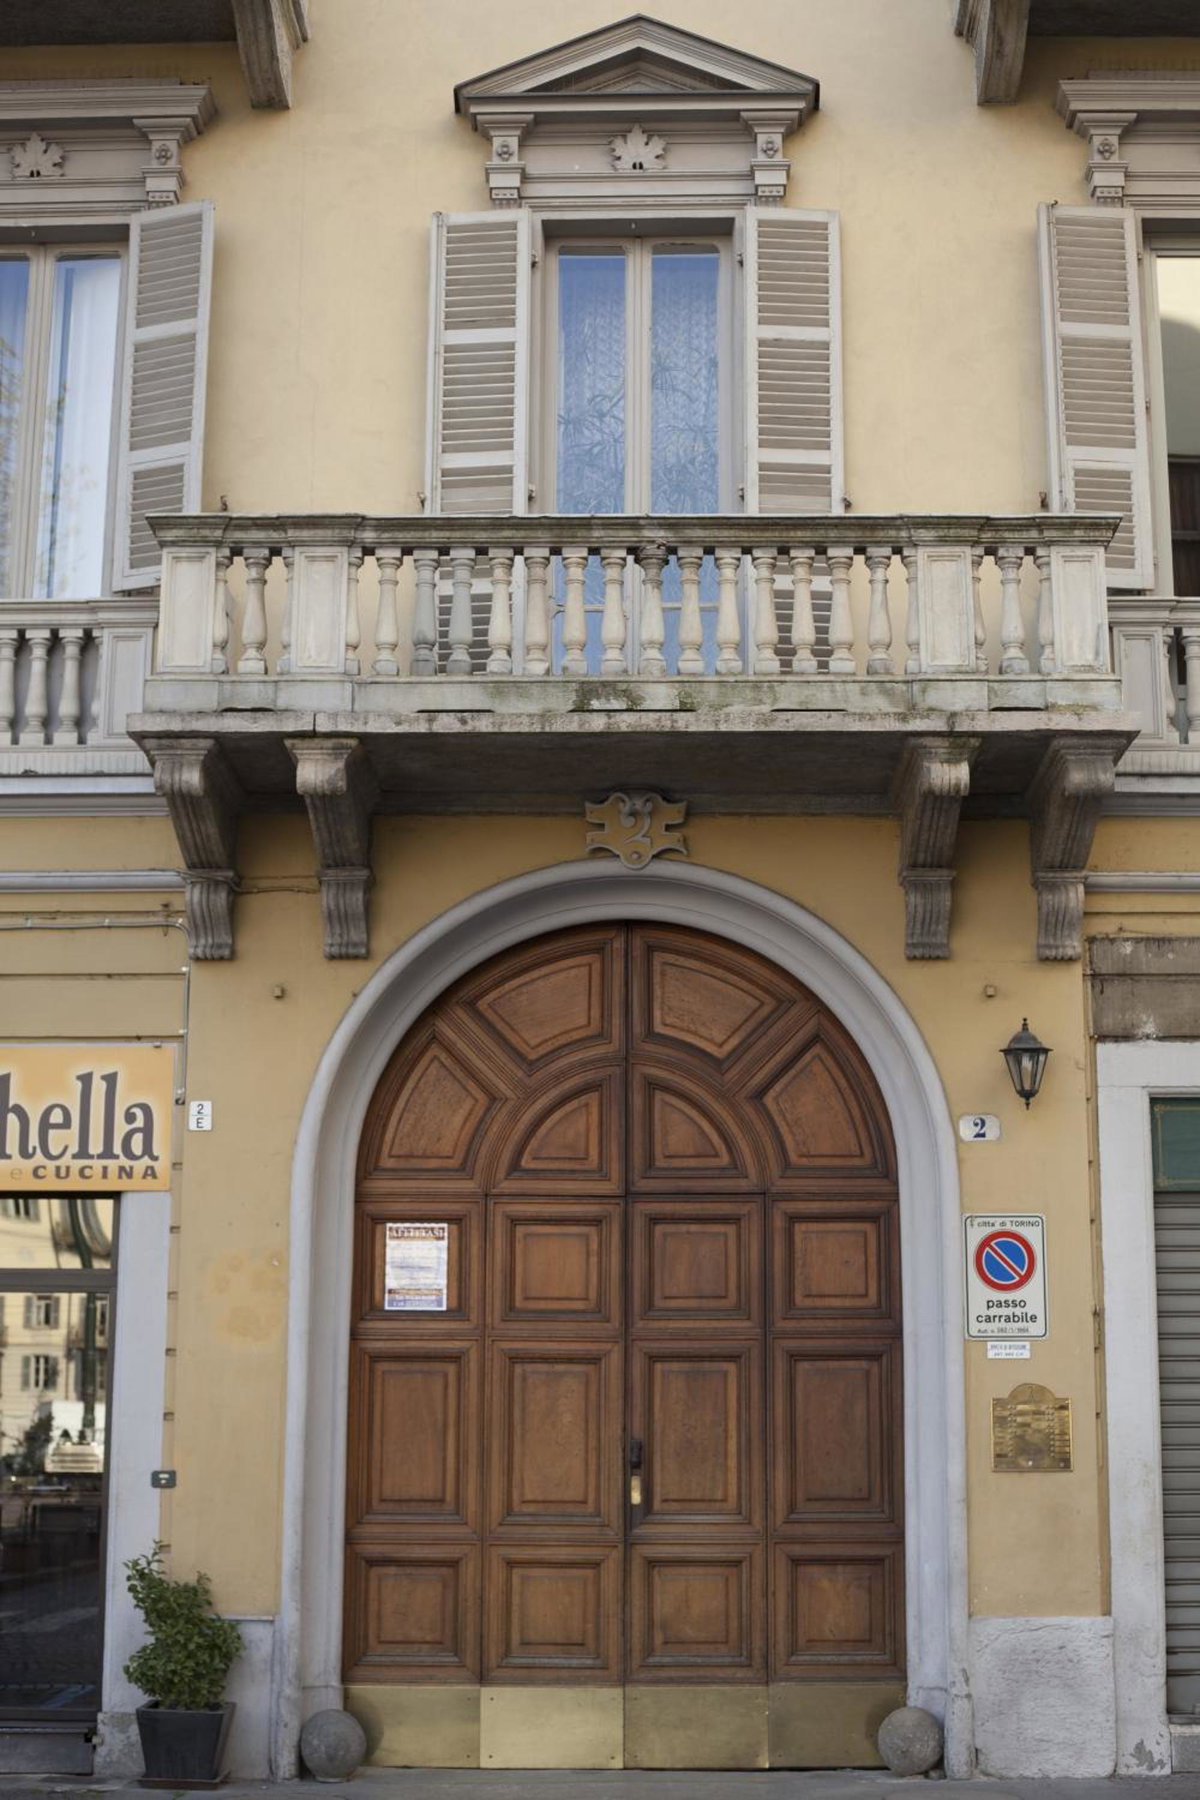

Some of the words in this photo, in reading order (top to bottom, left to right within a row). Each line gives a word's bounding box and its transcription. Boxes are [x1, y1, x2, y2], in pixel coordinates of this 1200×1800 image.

[620, 803, 652, 847] 2
[197, 1103, 204, 1115] 2
[196, 1117, 204, 1129] E
[973, 1117, 986, 1138] 2
[10, 1168, 23, 1180] e
[32, 1165, 158, 1180] CUCINA
[999, 1219, 1007, 1228] di
[1010, 1219, 1040, 1228] TORINO
[986, 1298, 1027, 1310] passo
[976, 1311, 1038, 1324] carrabile
